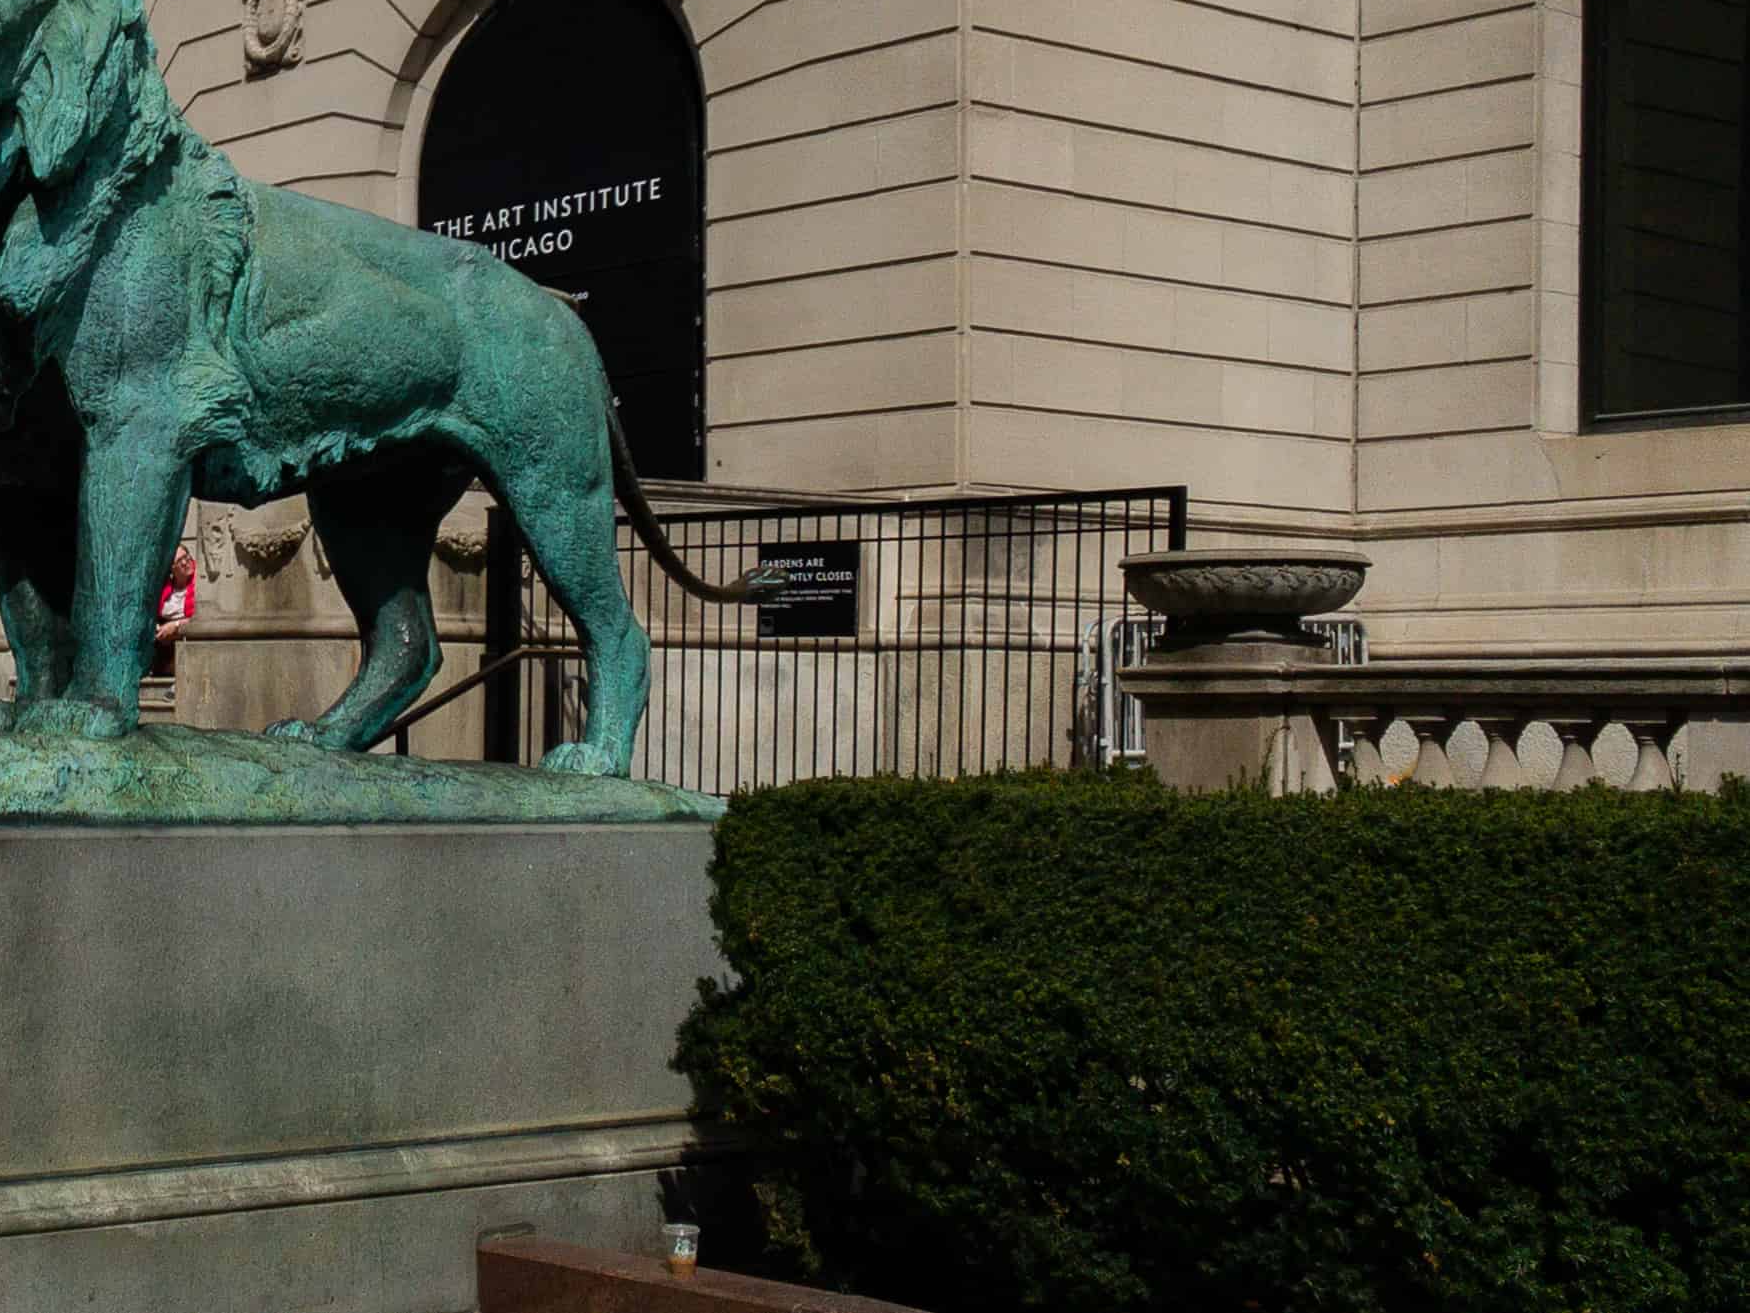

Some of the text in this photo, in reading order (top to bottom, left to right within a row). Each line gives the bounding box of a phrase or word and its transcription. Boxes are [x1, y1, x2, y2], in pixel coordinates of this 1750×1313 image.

[433, 178, 662, 238] THE ART INSTITUTE
[761, 557, 825, 569] GARDENS ARE
[789, 572, 813, 582] NTLY
